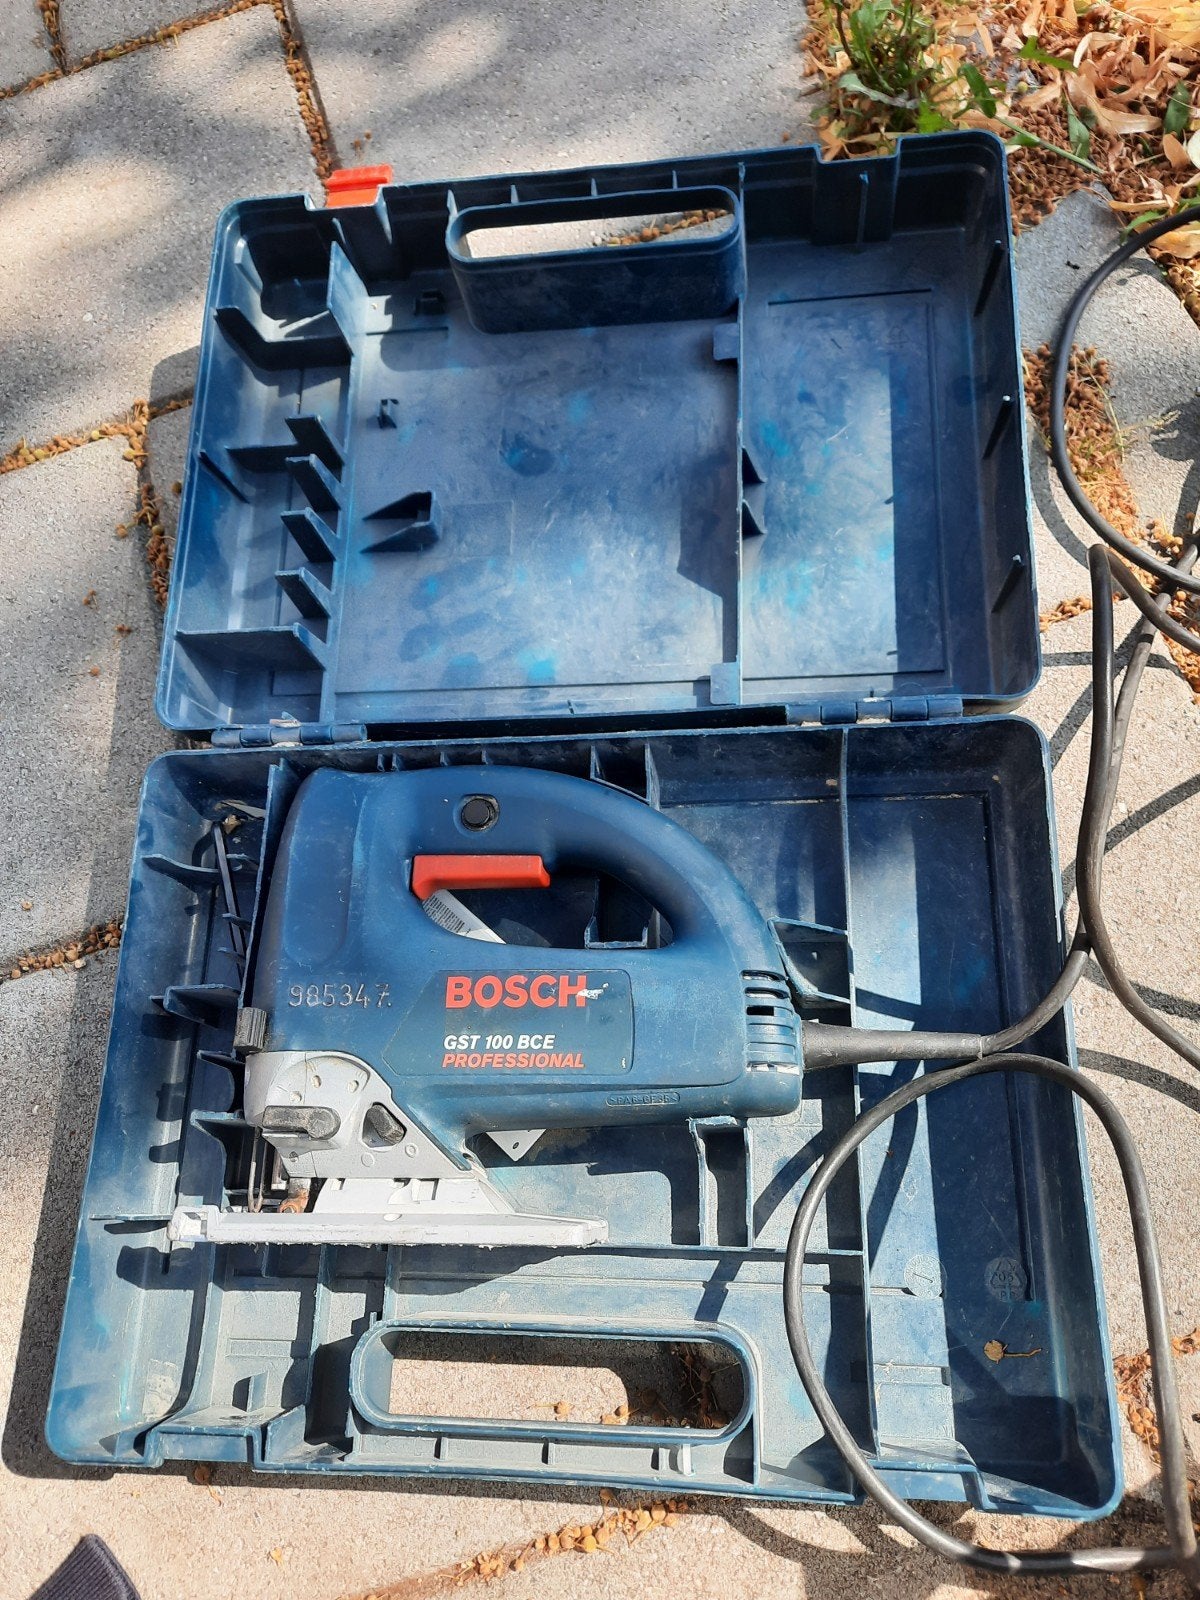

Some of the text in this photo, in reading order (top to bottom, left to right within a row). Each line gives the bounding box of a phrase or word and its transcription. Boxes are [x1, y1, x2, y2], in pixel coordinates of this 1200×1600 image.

[445, 974, 587, 1009] BOSCH
[443, 1034, 556, 1050] GST 100 BCE
[442, 1052, 585, 1069] PROFESSIONAL
